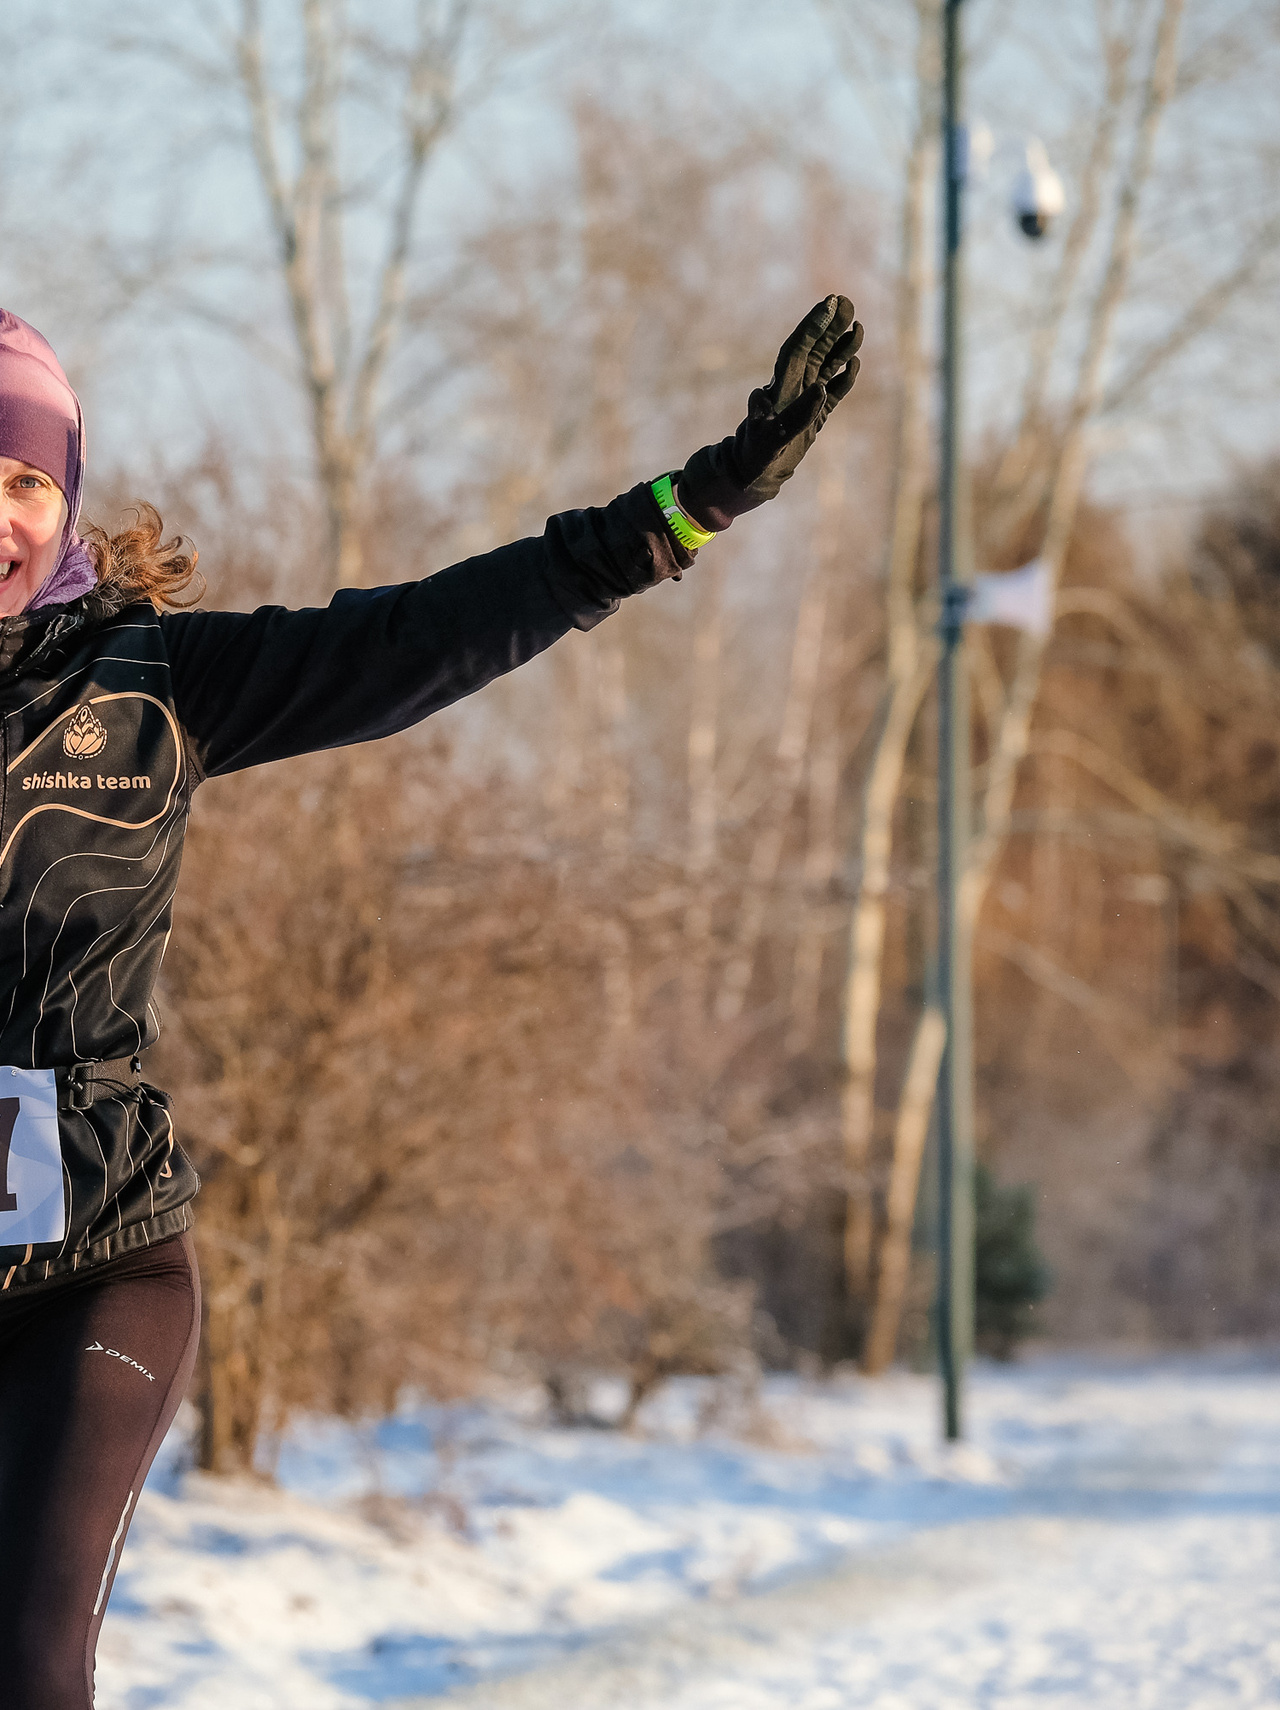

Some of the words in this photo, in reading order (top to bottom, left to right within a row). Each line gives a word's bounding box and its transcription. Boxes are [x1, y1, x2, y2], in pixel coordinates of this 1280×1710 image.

[22, 771, 92, 790] shishka
[96, 774, 151, 790] team
[105, 1348, 155, 1381] DEMIX
